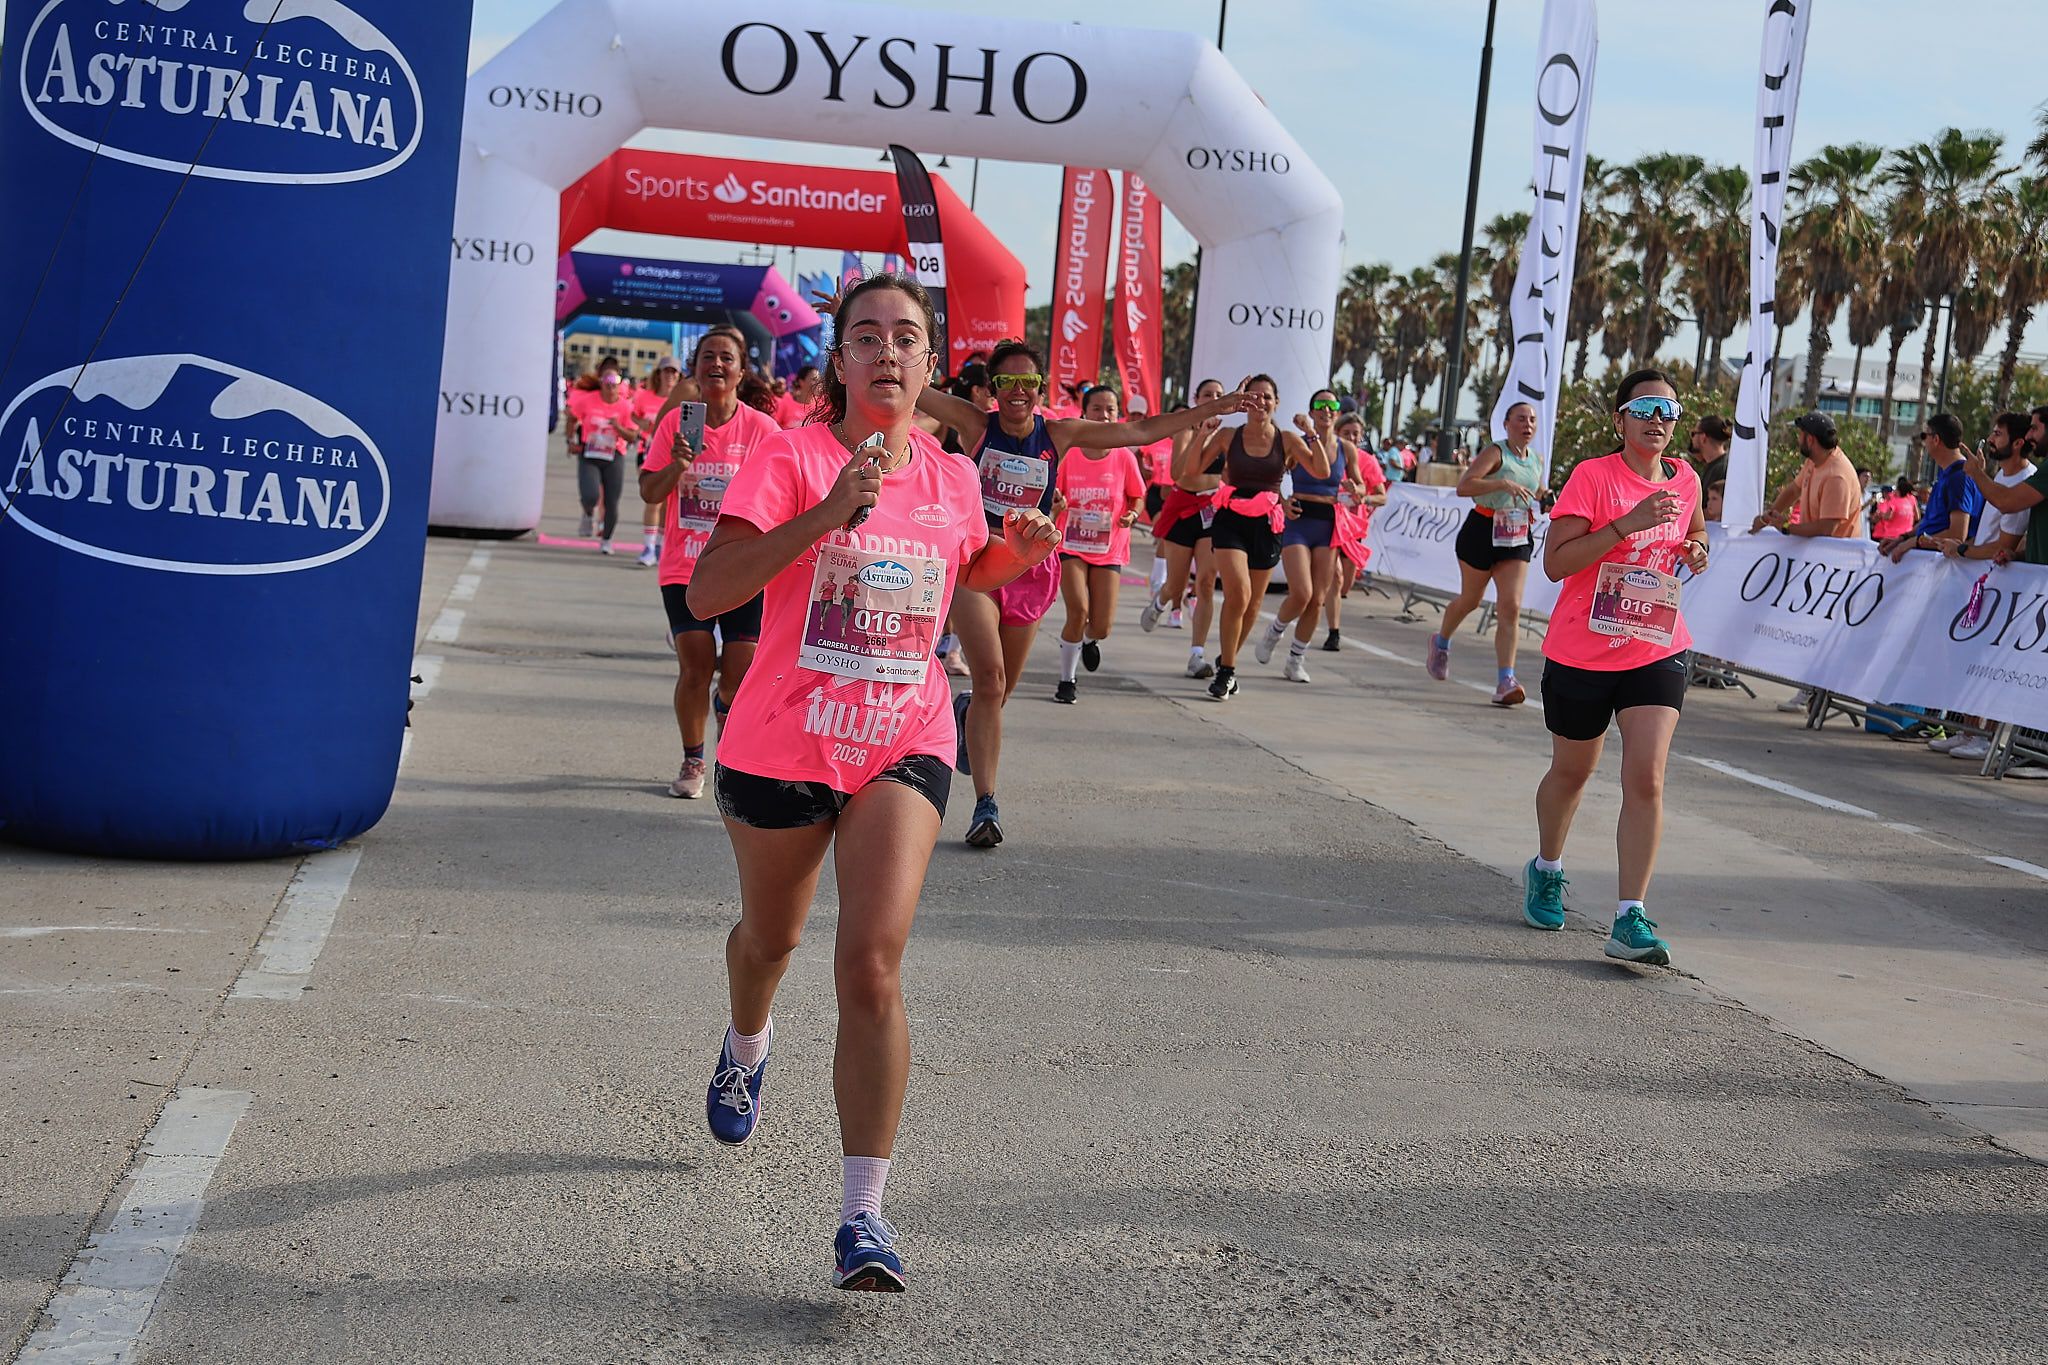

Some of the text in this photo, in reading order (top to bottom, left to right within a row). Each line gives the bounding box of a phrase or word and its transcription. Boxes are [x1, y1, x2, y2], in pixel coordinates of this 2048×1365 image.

[94, 20, 393, 86] CENTRAL LECHERA
[721, 22, 1088, 124] OYSHO
[36, 23, 399, 151] ASTURIANA
[489, 86, 603, 118] OYSHO
[1187, 147, 1290, 175] OYSHO
[625, 168, 887, 214] Sports Santander
[452, 238, 534, 266] YSHO
[1229, 303, 1324, 331] OYSHO
[441, 391, 524, 419] YSHO
[64, 417, 359, 469] CENTRAL LECHERA
[6, 416, 365, 531] ASTURIANA
[687, 462, 740, 477] ARRER
[997, 482, 1024, 496] 016
[1070, 487, 1110, 500] CARRERA
[1080, 529, 1098, 537] 016
[830, 557, 858, 569] SUMA
[863, 569, 909, 585] ASTURIANA
[1740, 552, 1884, 627] OYSHO
[1620, 598, 1653, 615] 016
[854, 609, 901, 634] 016
[1598, 624, 1623, 632] OYSHO
[817, 639, 849, 651] CARRERA
[850, 644, 860, 653] DE
[861, 647, 870, 655] LA
[871, 648, 891, 657] MUJER
[865, 636, 887, 646] 2668
[816, 653, 860, 670] OYSHO
[1966, 664, 2048, 689] WWW.OYSHO.CO
[864, 680, 894, 708] LA
[803, 699, 906, 747] MUJER
[831, 743, 867, 767] 2026
